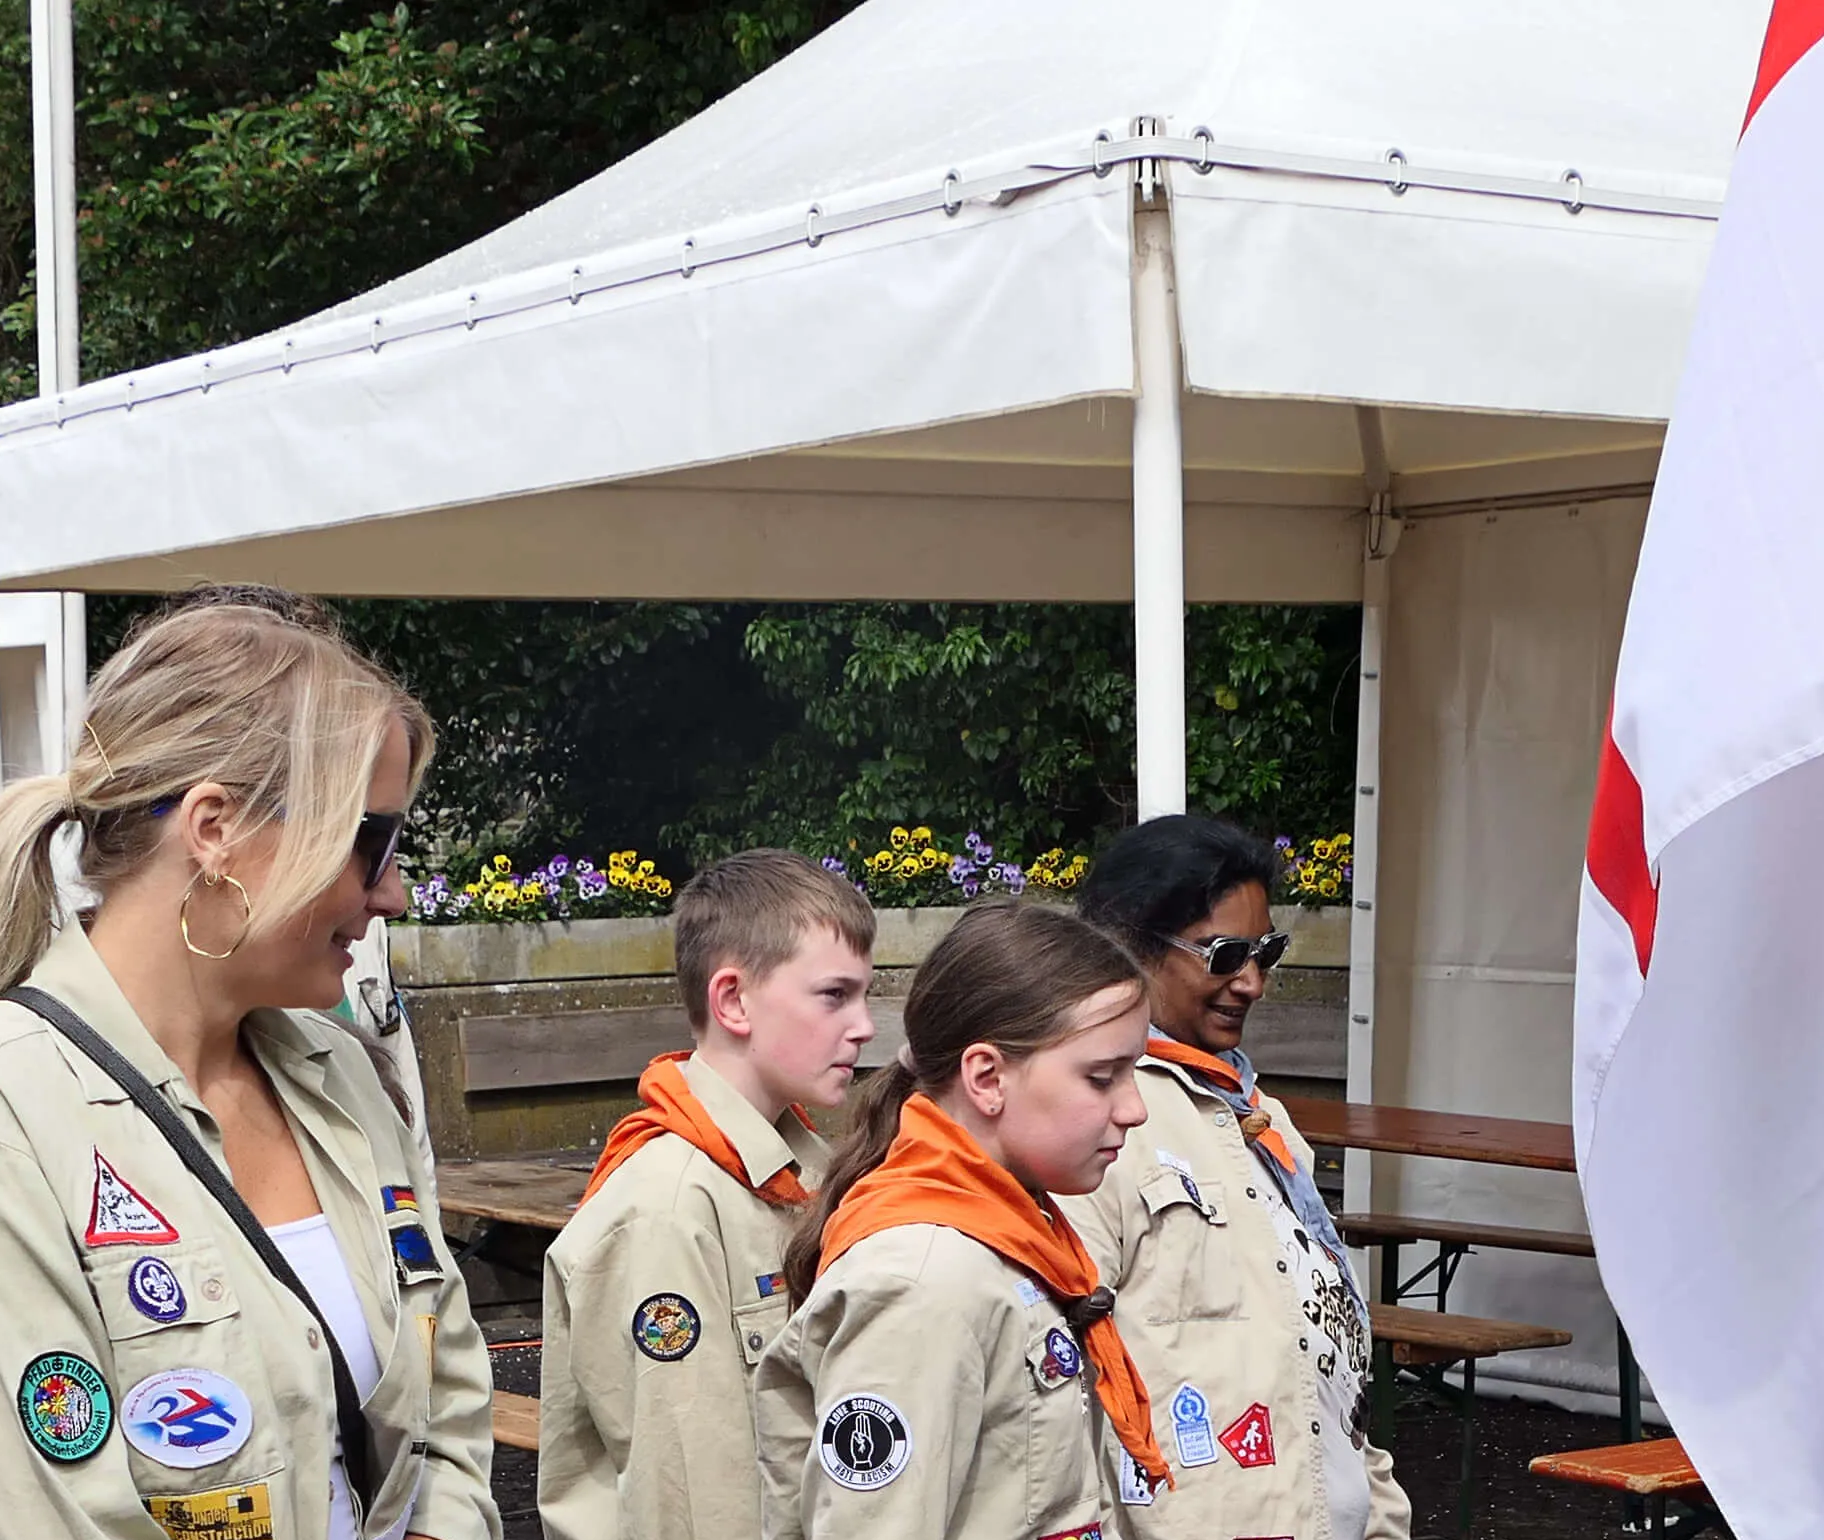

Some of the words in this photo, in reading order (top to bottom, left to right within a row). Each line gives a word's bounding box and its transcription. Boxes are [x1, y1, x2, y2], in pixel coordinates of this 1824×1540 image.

[26, 1360, 52, 1387] PFAD
[66, 1360, 102, 1395] FINDER
[829, 1404, 849, 1425] LOVE
[851, 1399, 895, 1424] SCOUTING
[834, 1463, 854, 1481] HATE
[861, 1462, 896, 1482] RACISM
